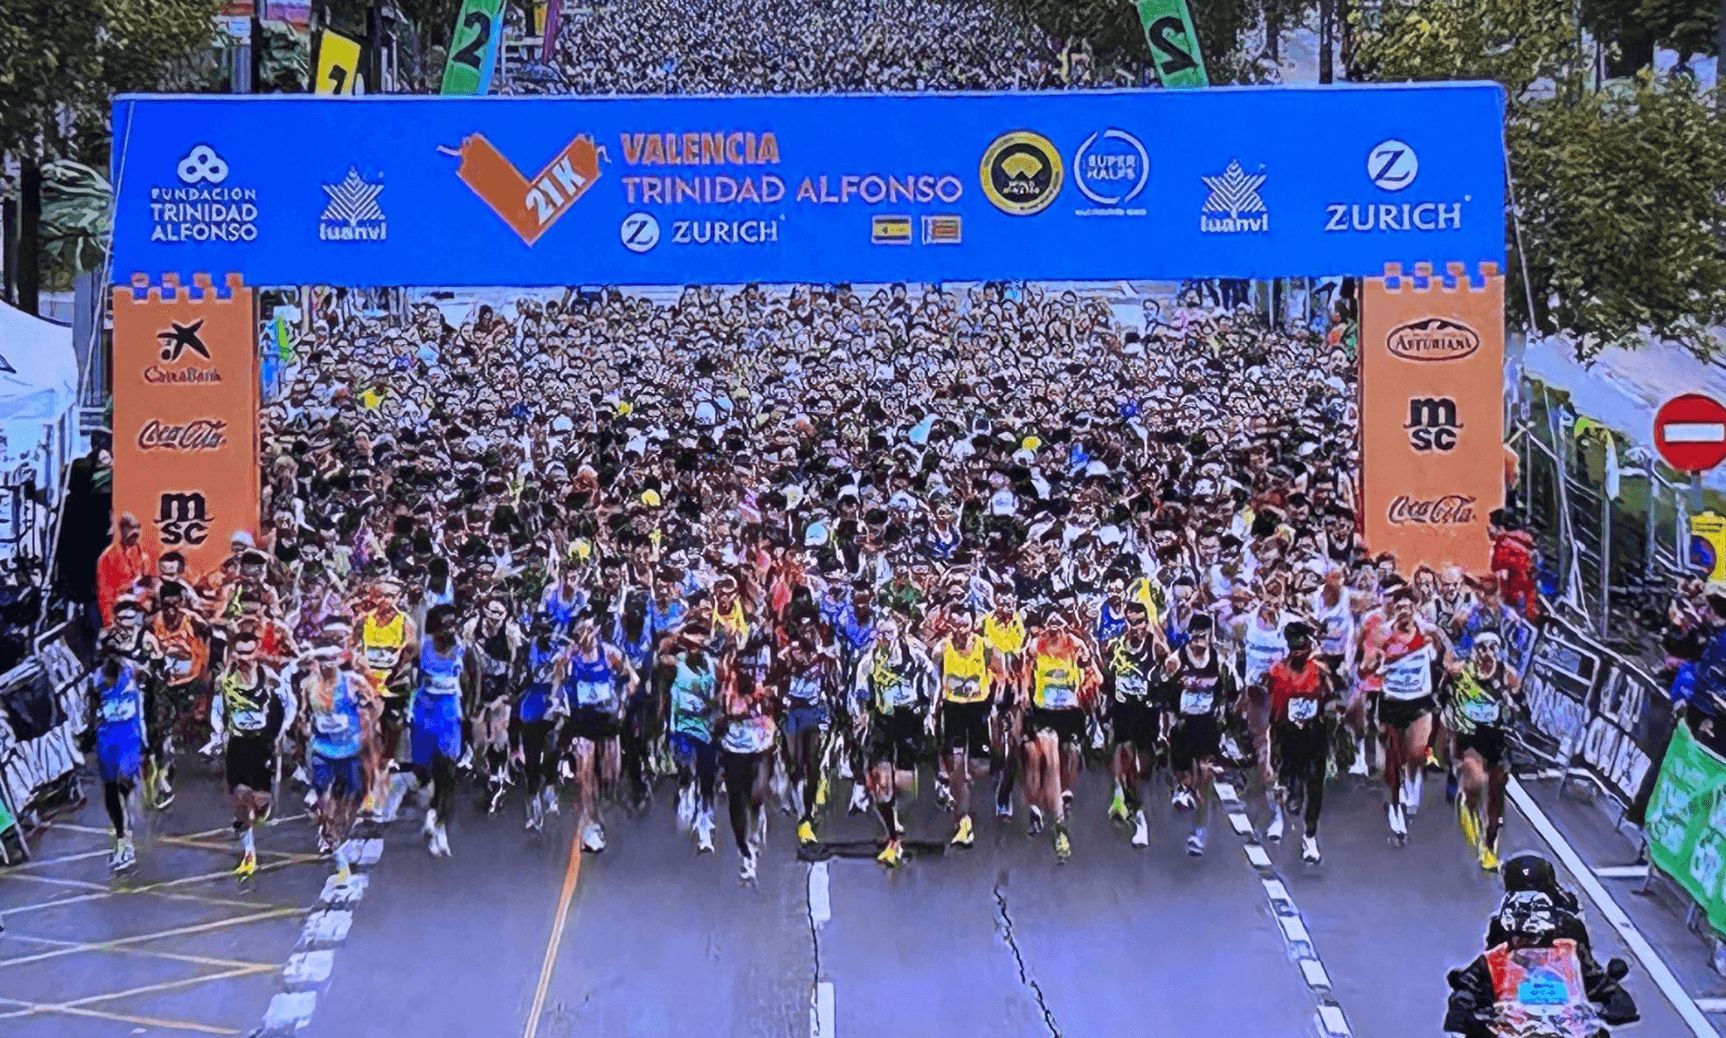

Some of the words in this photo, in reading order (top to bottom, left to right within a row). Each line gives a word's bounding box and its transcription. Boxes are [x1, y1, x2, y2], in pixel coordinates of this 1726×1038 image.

[453, 12, 491, 68] 2
[620, 132, 780, 164] VALENCIA
[525, 155, 586, 225] 21K
[621, 176, 785, 205] TRINIDAD
[796, 174, 963, 204] ALFONSO
[150, 203, 258, 221] TRINIDAD
[1325, 202, 1462, 231] ZURICH
[151, 223, 258, 241] ALFONSO
[671, 221, 779, 244] ZURICH
